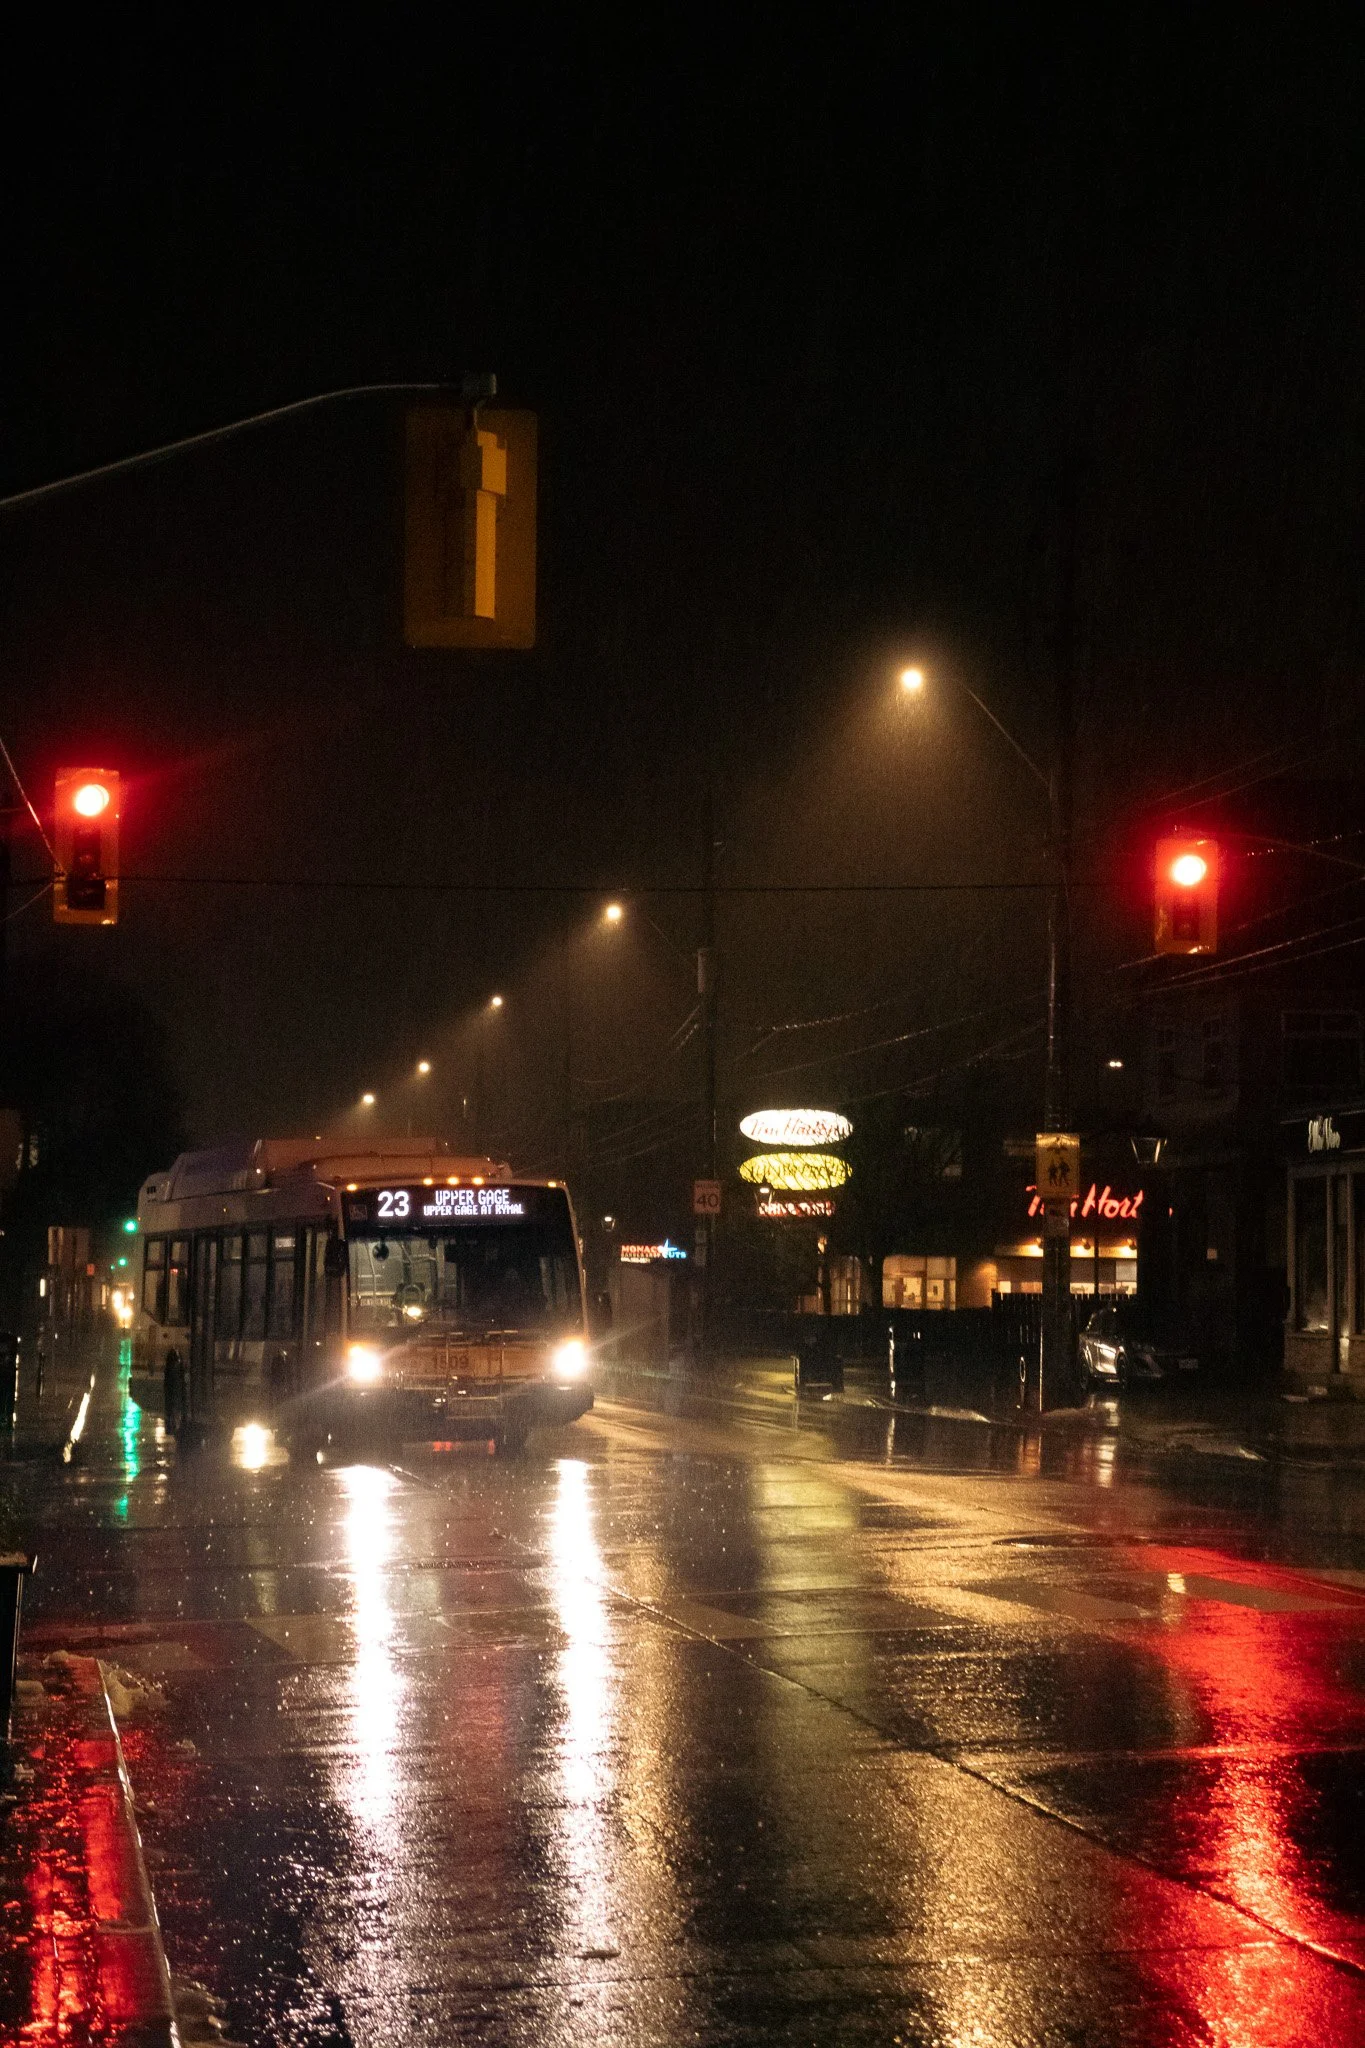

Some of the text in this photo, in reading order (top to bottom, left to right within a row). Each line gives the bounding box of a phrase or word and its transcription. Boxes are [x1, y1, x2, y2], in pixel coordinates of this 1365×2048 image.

[749, 1118, 779, 1136] Tim
[377, 1191, 410, 1217] 23
[435, 1189, 510, 1206] UPPER GAGE
[696, 1193, 719, 1208] 40
[423, 1203, 524, 1216] UPPER GAGE AT RYMAL
[431, 1352, 469, 1370] 1509
